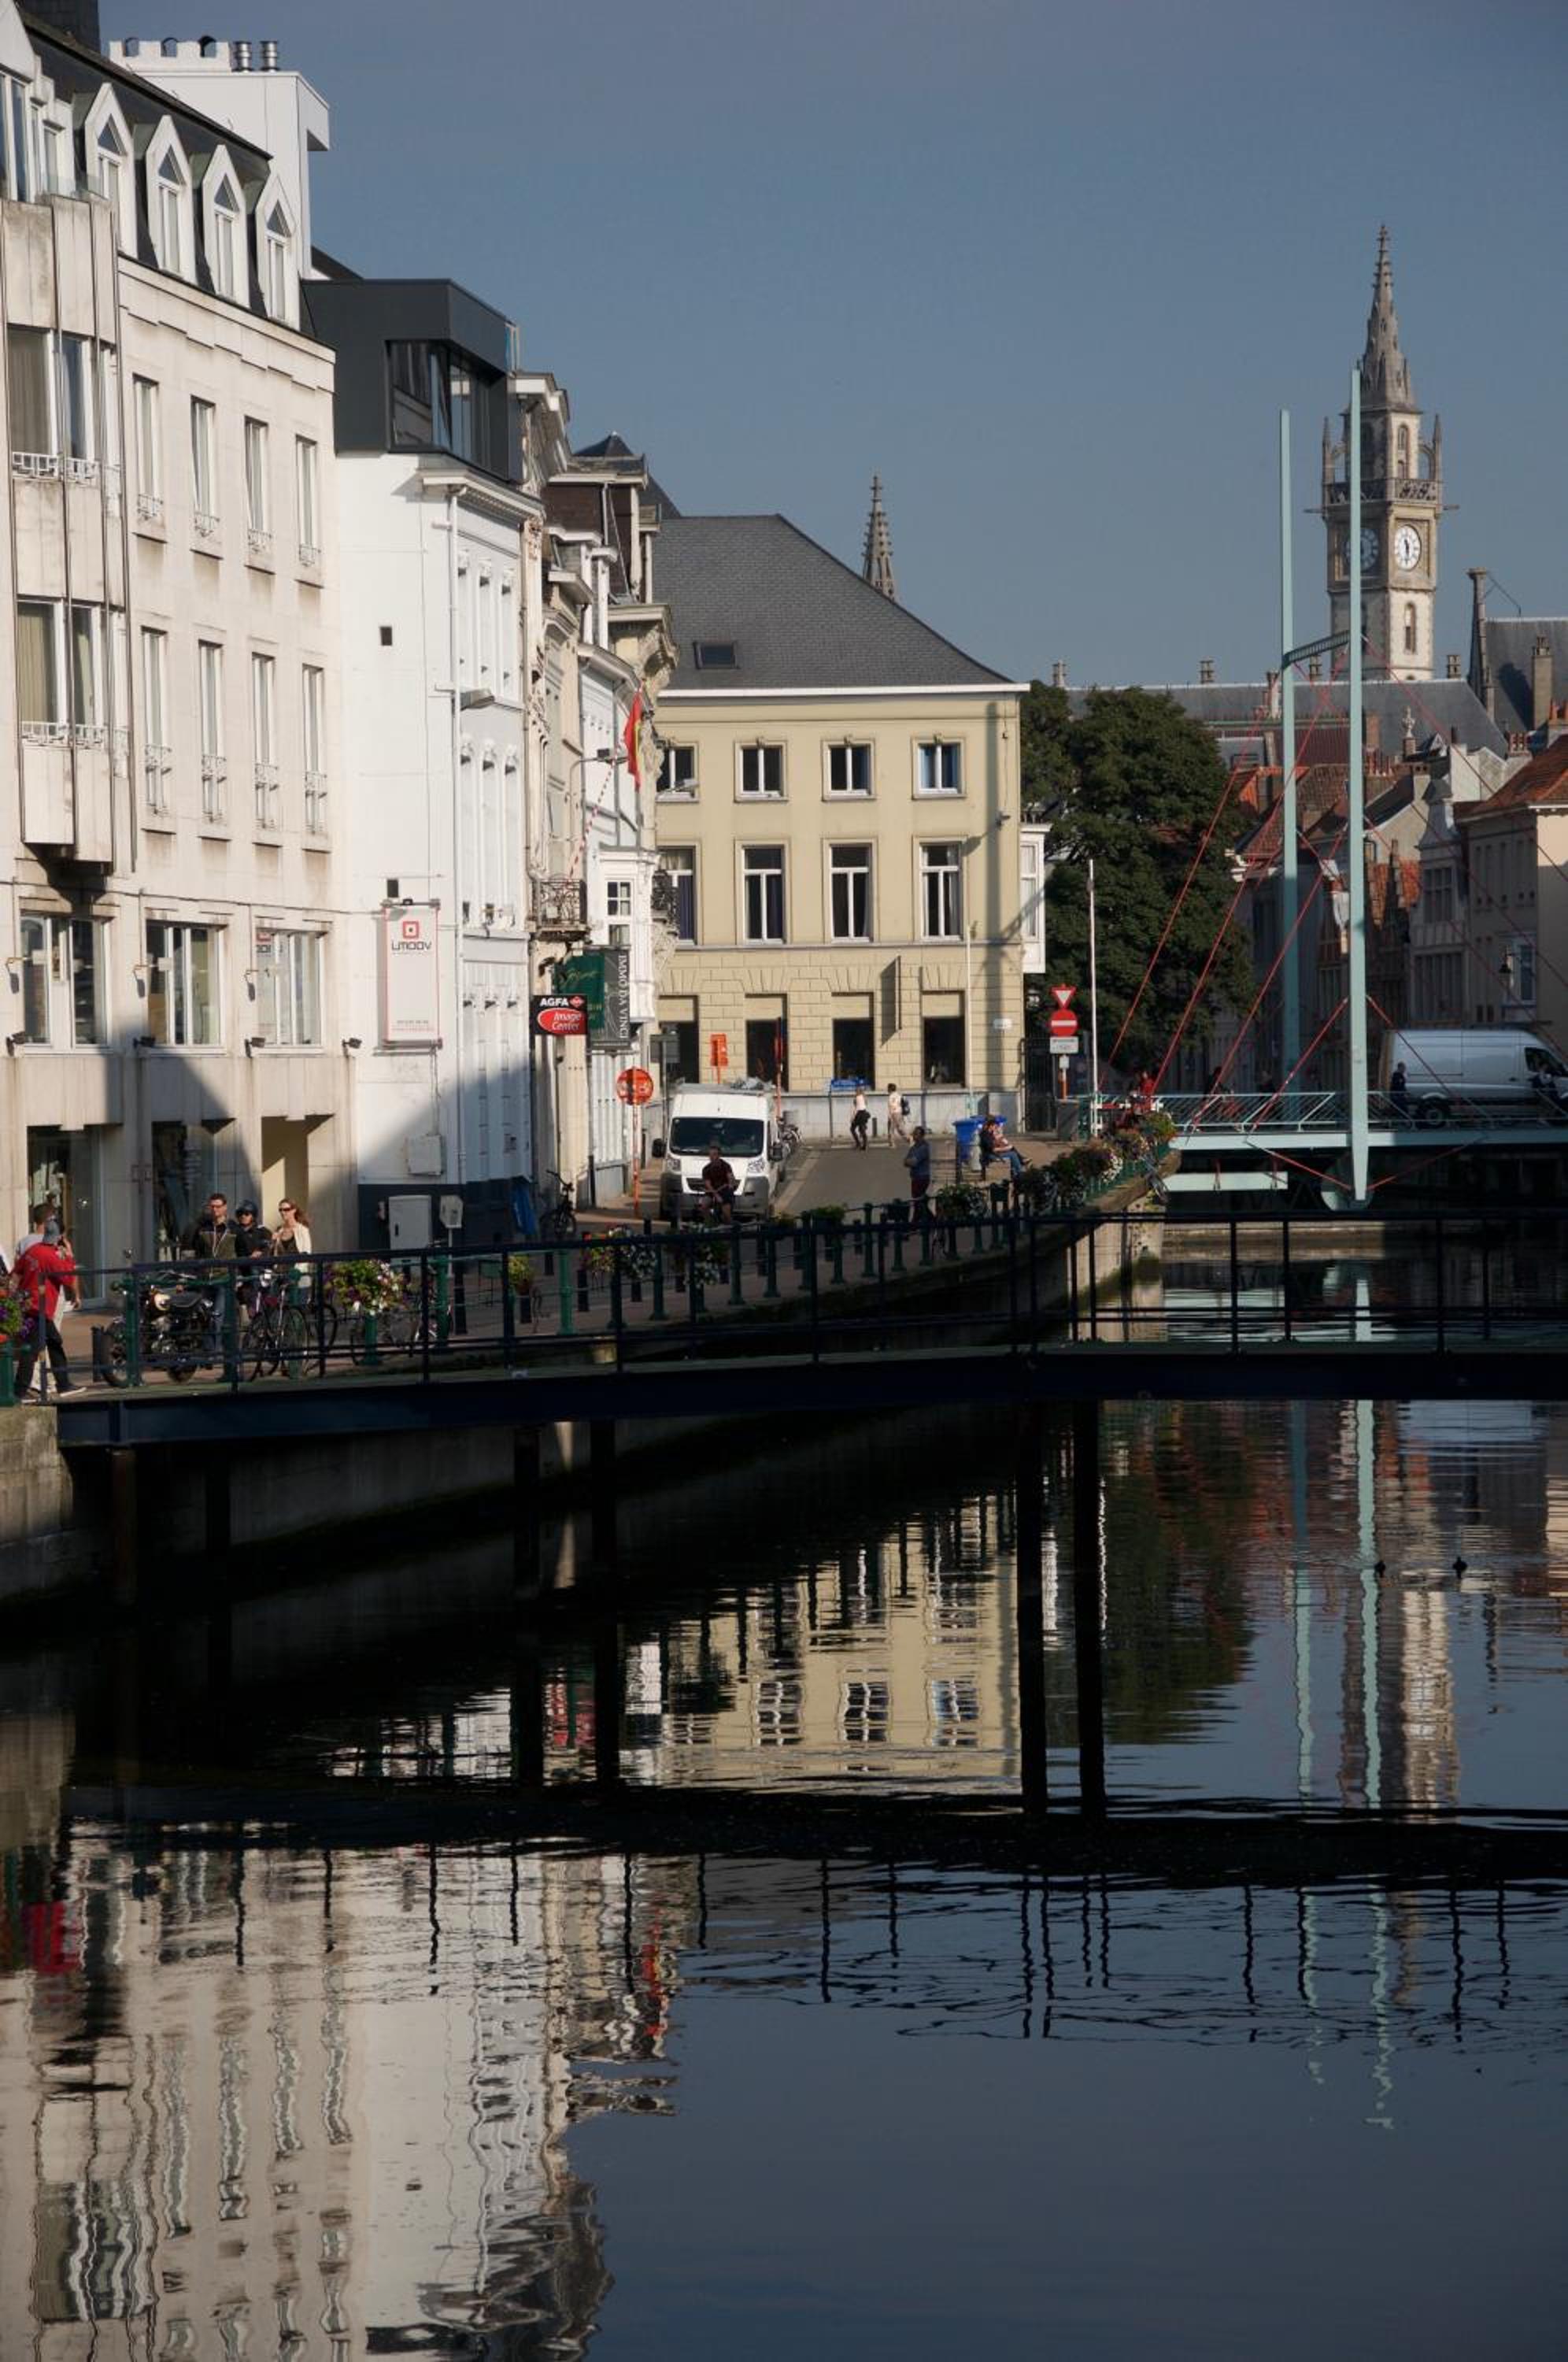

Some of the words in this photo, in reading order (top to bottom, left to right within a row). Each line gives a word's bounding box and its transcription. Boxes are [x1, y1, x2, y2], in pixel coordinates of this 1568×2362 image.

[618, 955, 627, 987] IMMO
[539, 998, 569, 1006] AGFA
[619, 990, 627, 1005] DA
[553, 1012, 581, 1022] Image
[552, 1022, 579, 1031] Center
[619, 1009, 629, 1038] VINCI
